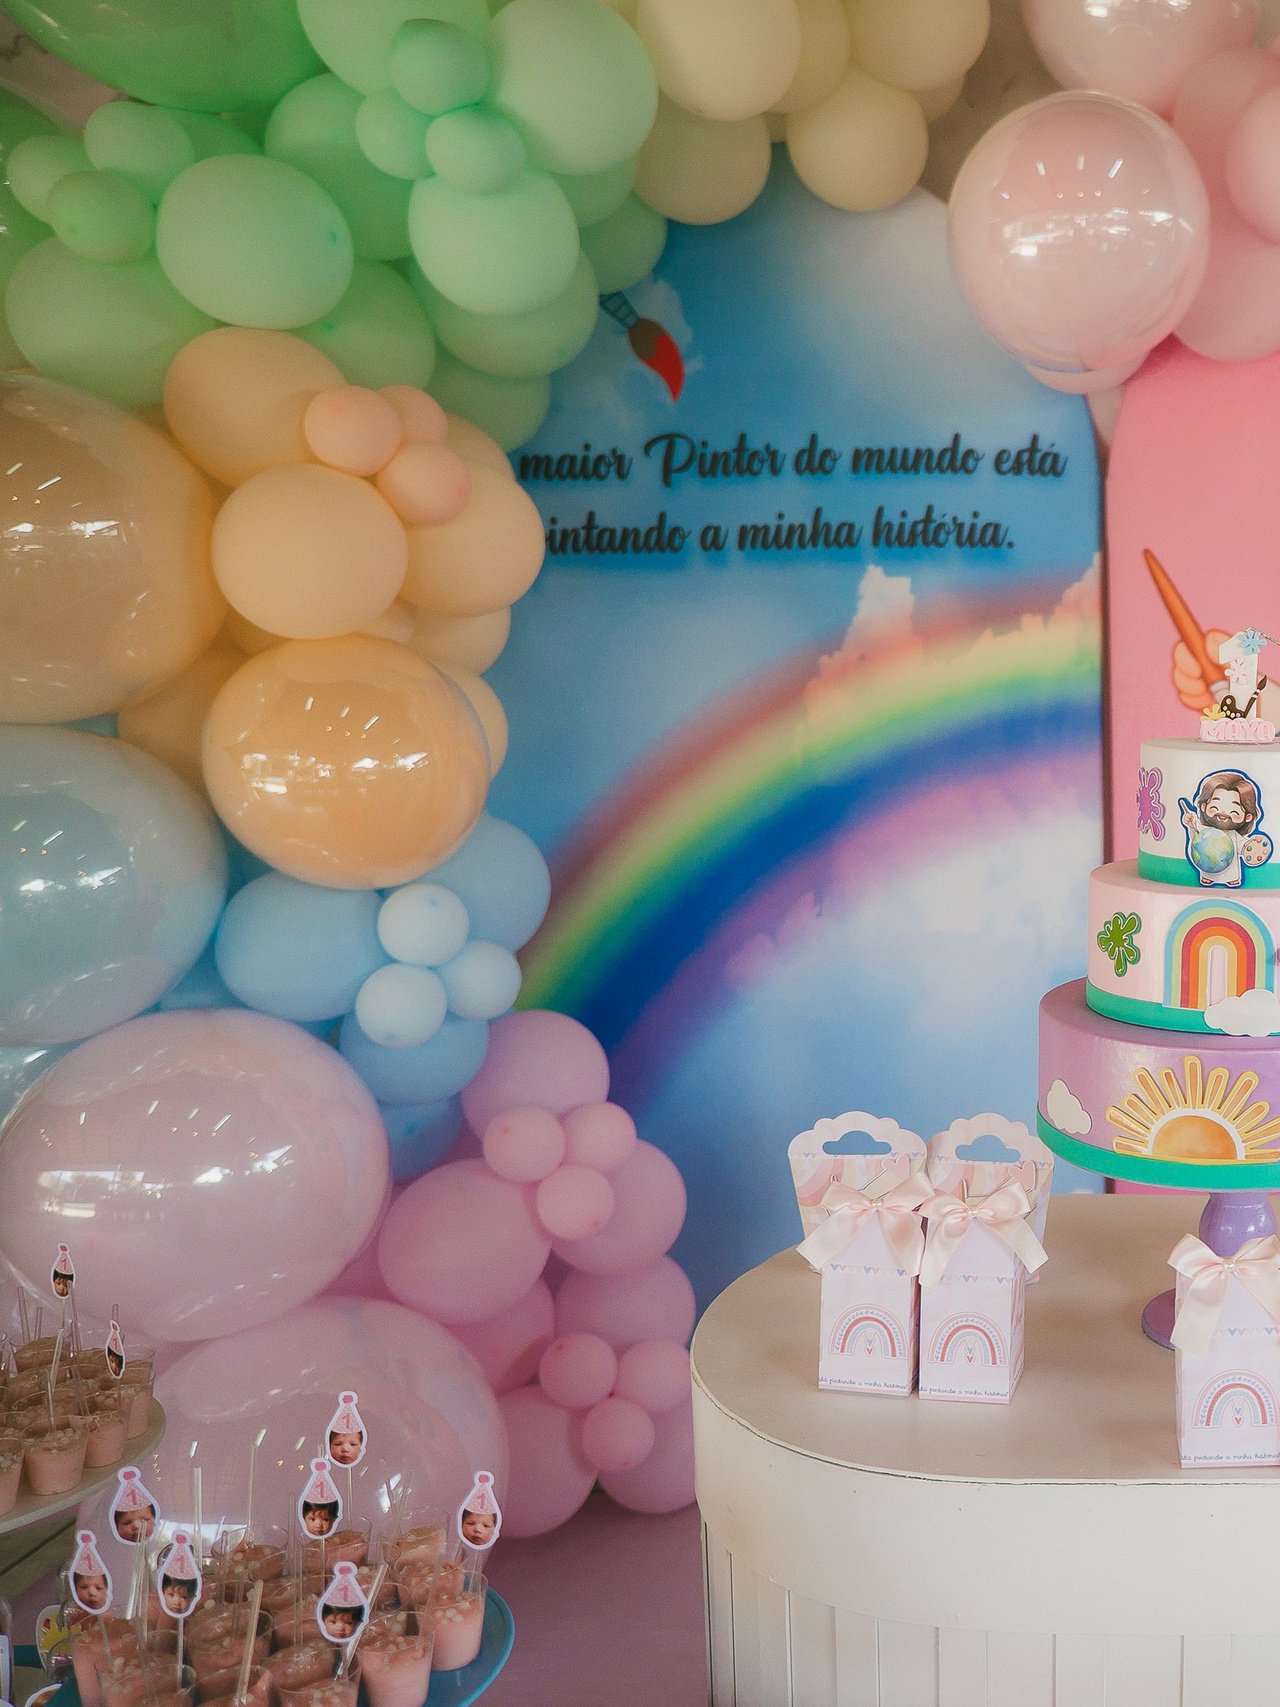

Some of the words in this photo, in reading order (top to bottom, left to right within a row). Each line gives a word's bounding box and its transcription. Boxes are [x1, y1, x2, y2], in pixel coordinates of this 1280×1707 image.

[519, 443, 633, 481] maior
[643, 432, 787, 488] Pintor
[793, 433, 842, 476] do
[851, 433, 986, 475] mundo
[993, 433, 1068, 478] está
[545, 510, 692, 555] intando
[700, 523, 729, 551] a
[737, 506, 863, 551] minha
[872, 504, 1015, 549] história.
[1201, 720, 1276, 741] MAYA
[61, 1258, 67, 1271] 1
[341, 1412, 350, 1429] 1
[126, 1489, 137, 1505] 1
[315, 1481, 325, 1498] 1
[476, 1493, 485, 1510] 1
[84, 1553, 93, 1571] 1
[177, 1554, 184, 1574] 1
[338, 1585, 348, 1602] 1
